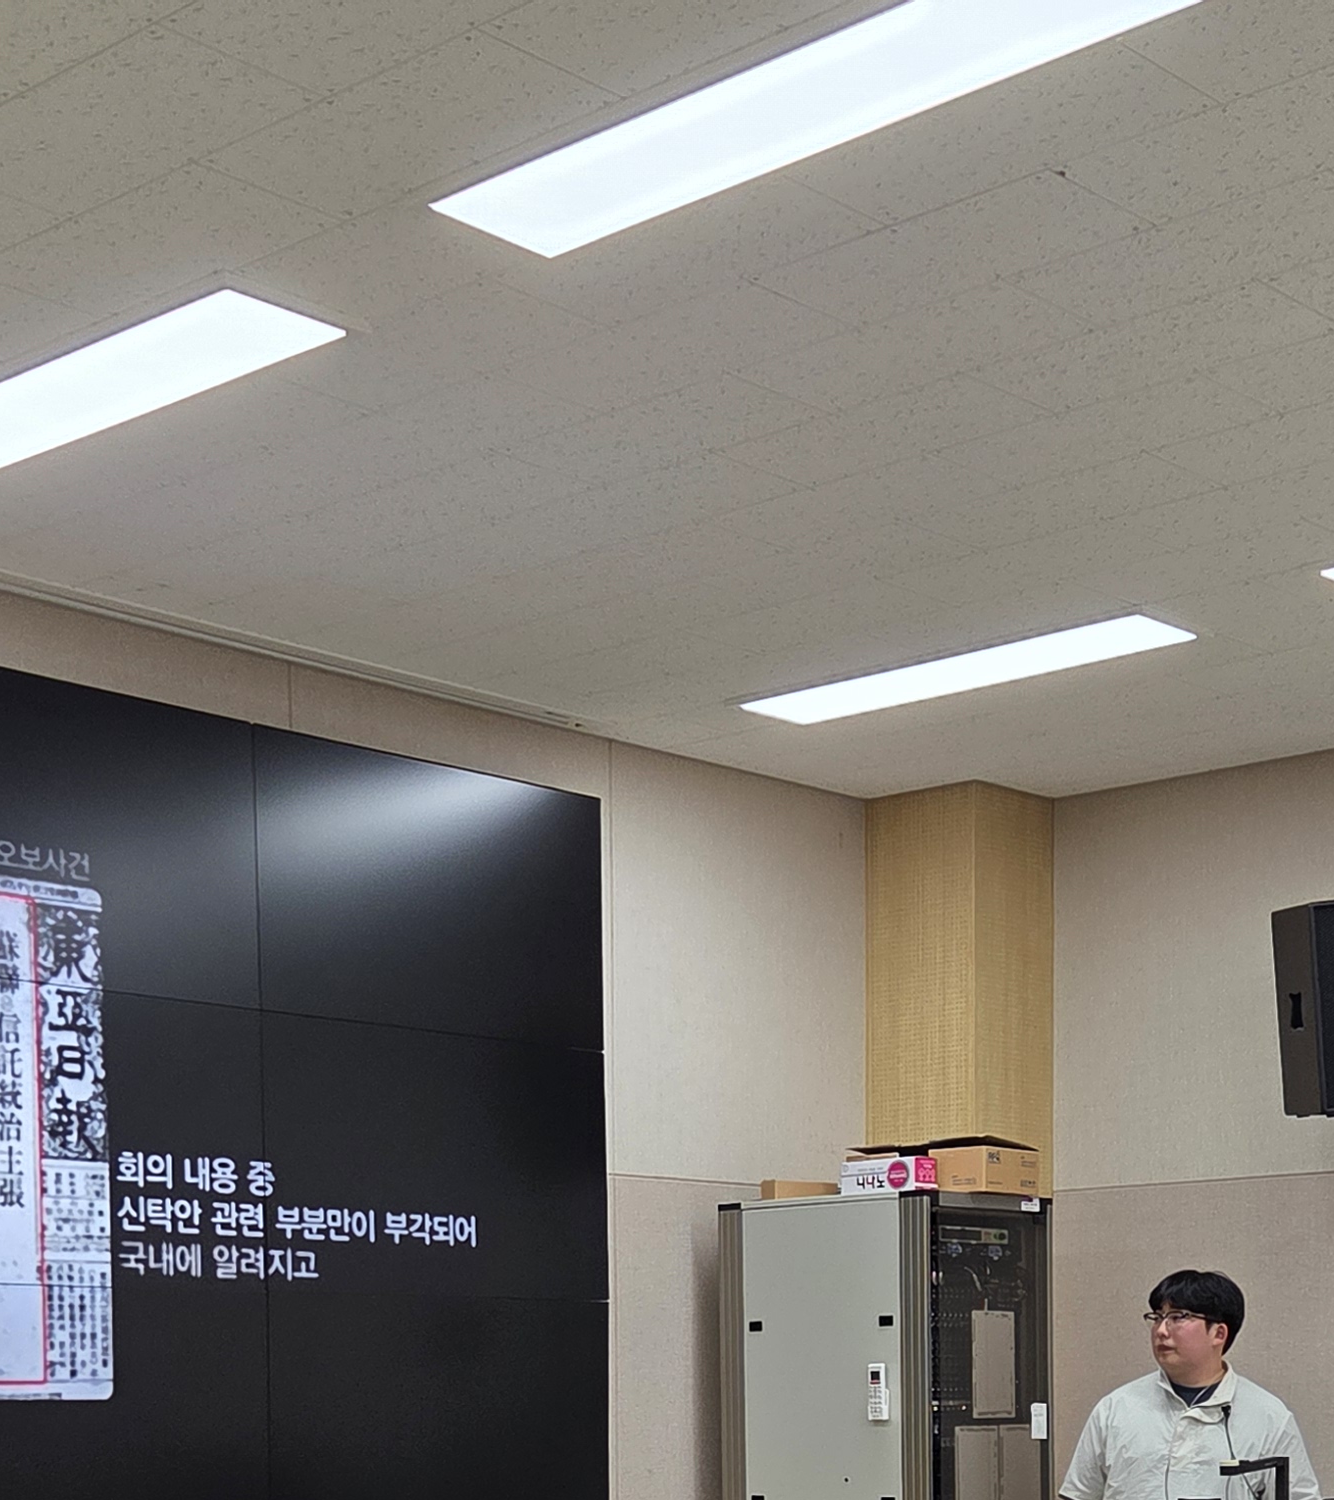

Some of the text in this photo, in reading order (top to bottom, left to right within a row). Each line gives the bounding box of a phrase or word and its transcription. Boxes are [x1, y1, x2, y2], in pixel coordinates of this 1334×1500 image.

[116, 1151, 276, 1197] 회의 내용 중
[116, 1196, 203, 1235] 신탁안
[211, 1201, 265, 1238] 관련
[275, 1206, 376, 1244] 부분만이
[384, 1211, 478, 1248] 부각되어
[118, 1240, 320, 1282] 국내에 알려지고
